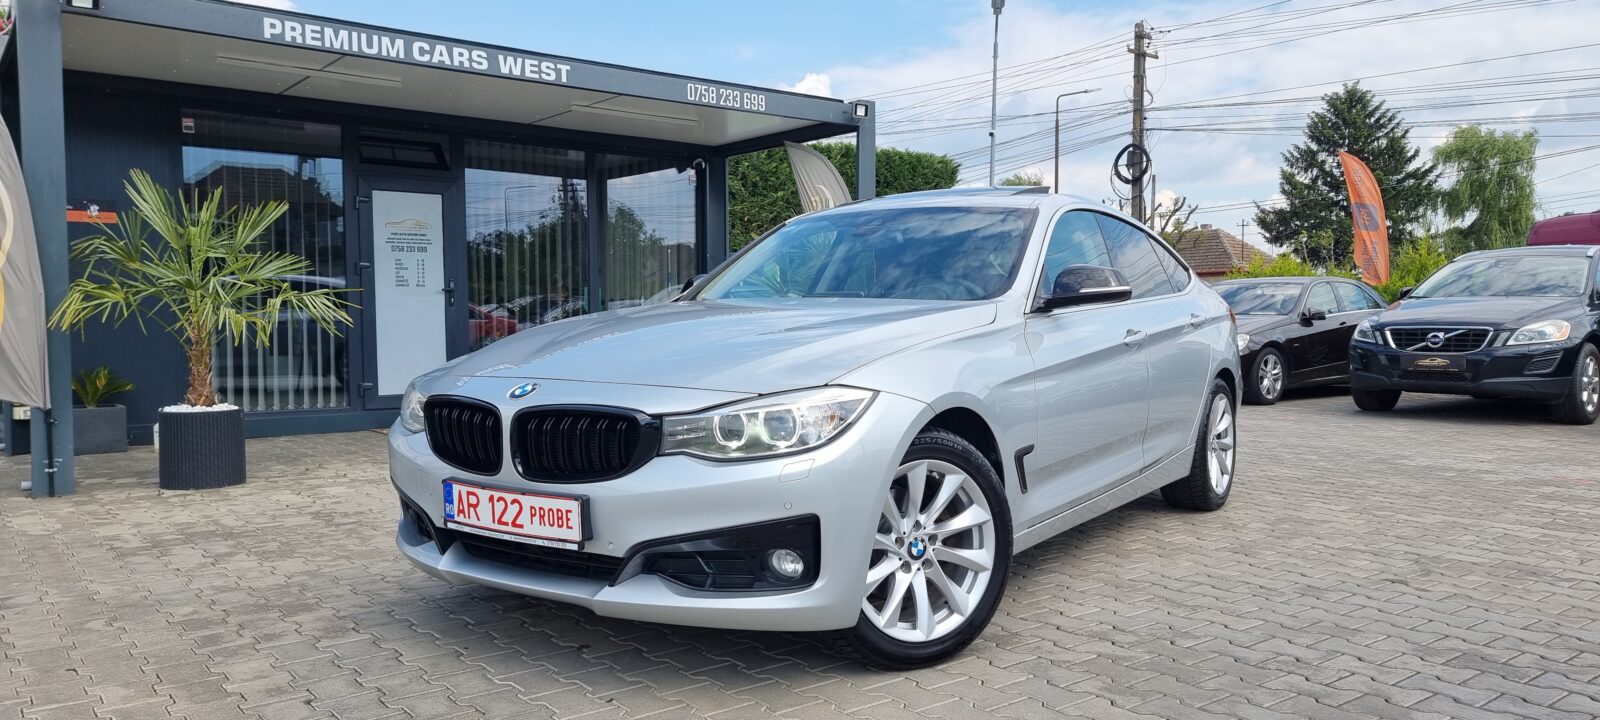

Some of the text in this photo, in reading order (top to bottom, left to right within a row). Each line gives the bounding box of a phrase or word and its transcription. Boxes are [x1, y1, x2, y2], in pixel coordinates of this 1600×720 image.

[263, 17, 571, 83] PREMIUM CARS WEST
[687, 83, 765, 111] 0758 233 699
[445, 489, 573, 530] RO AR 122 PROBE
